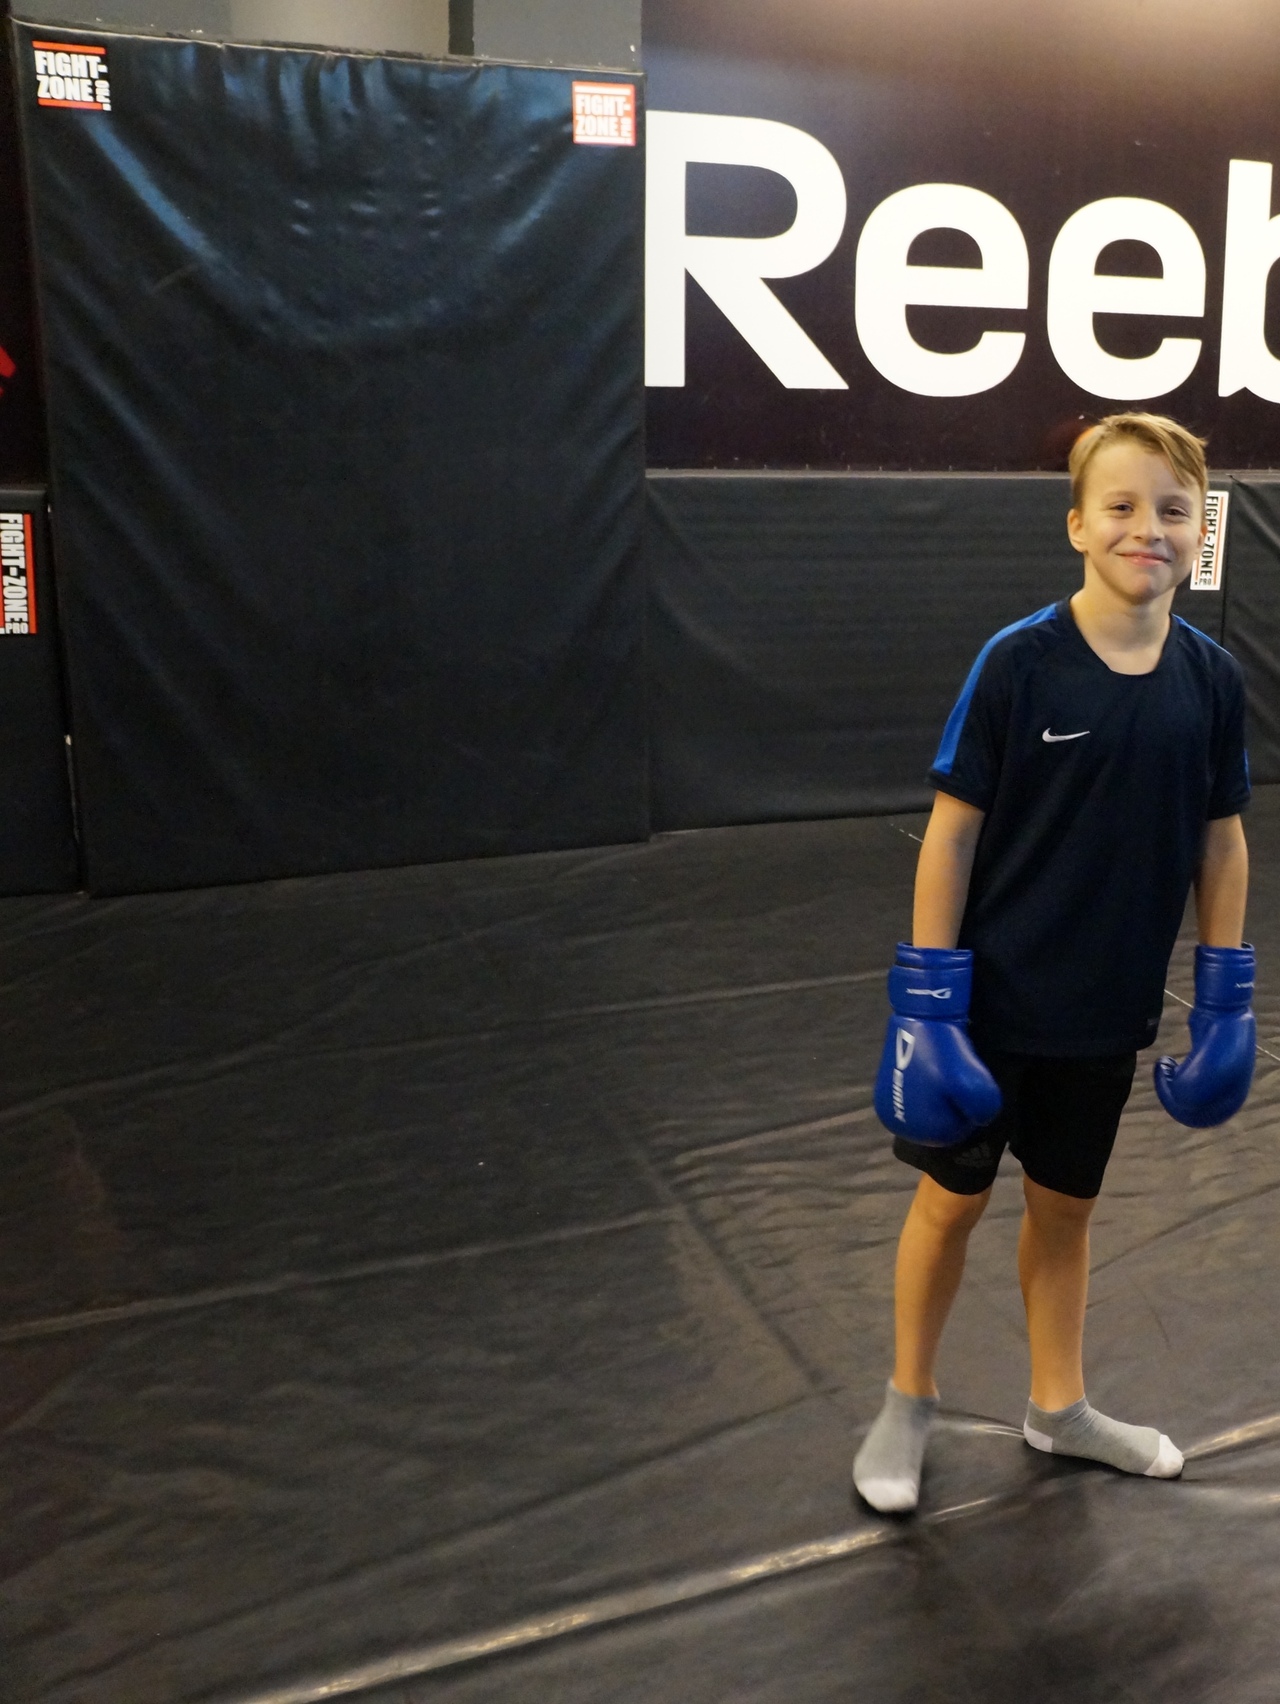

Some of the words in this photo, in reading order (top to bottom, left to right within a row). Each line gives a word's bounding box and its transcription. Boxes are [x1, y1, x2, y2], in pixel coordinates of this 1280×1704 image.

[34, 50, 108, 79] FIGHT-
[36, 75, 94, 102] ZONE
[575, 94, 631, 117] FIGHT-
[575, 115, 619, 137] ZONE
[1200, 496, 1218, 577] FIGHT-ZONE
[0, 513, 28, 622] FIGHT-ZONE
